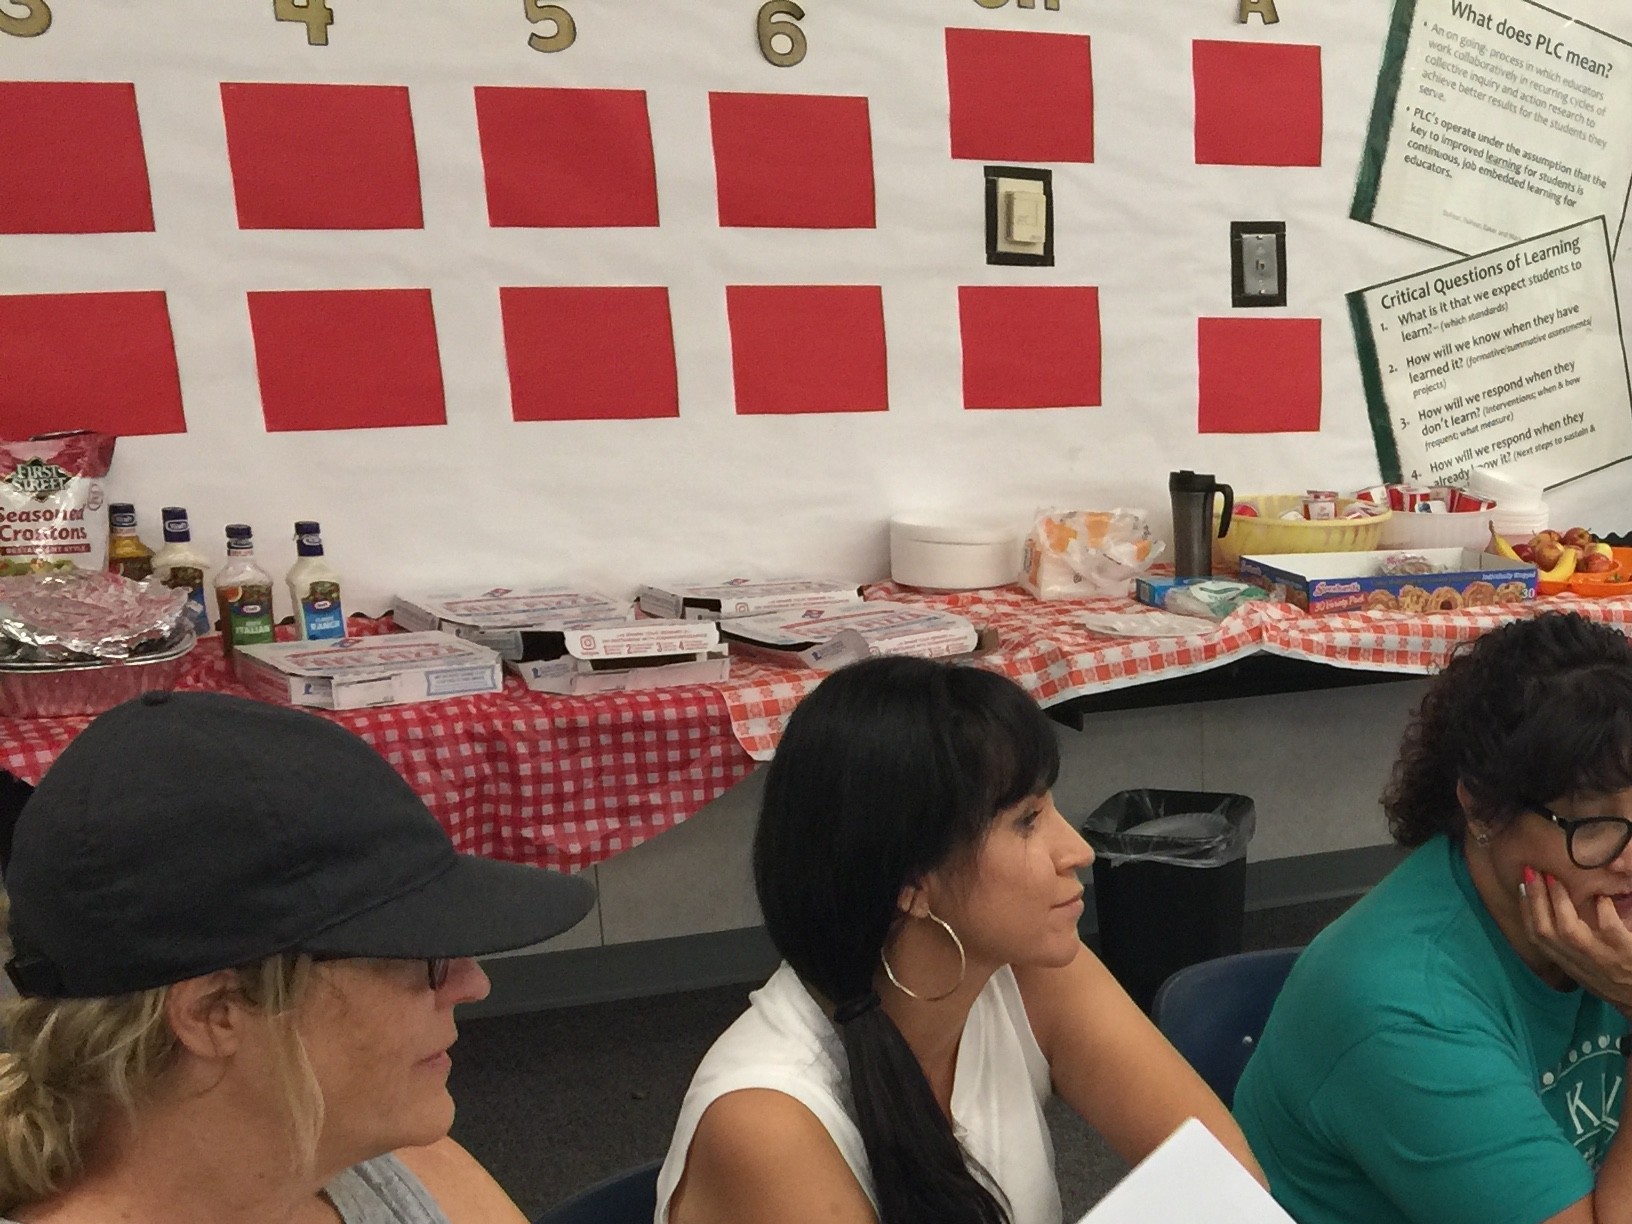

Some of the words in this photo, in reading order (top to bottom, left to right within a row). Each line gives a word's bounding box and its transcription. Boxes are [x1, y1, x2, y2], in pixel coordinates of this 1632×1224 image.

[273, 0, 334, 45] 4
[524, 0, 577, 53] 5
[756, 0, 807, 67] 6
[1451, 0, 1494, 31] What
[1495, 17, 1533, 47] does
[1535, 33, 1565, 60] PLC
[1565, 49, 1614, 79] mean?
[1403, 154, 1453, 179] educators.
[1409, 121, 1428, 140] key
[1429, 130, 1440, 143] to
[1440, 133, 1485, 159] improved
[1484, 149, 1523, 176] learning
[1523, 164, 1538, 178] for
[1538, 172, 1576, 193] students
[1575, 184, 1585, 196] is
[1440, 119, 1477, 140] operate
[1477, 133, 1505, 150] under
[1505, 142, 1521, 157] the
[1521, 149, 1573, 176] assumption
[1573, 167, 1592, 183] that
[1591, 175, 1608, 190] the
[1460, 156, 1478, 172] job
[1477, 165, 1527, 190] embedded
[1526, 180, 1563, 207] learning
[1563, 194, 1578, 208] for
[1380, 280, 1431, 310] Critical
[1433, 262, 1504, 297] Questions
[1506, 252, 1521, 272] of
[1523, 236, 1581, 267] Learning
[1397, 308, 1428, 327] What
[1428, 304, 1439, 317] is
[1439, 301, 1449, 313] it
[1449, 294, 1473, 311] that
[1472, 290, 1490, 303] we
[1491, 277, 1527, 297] expect
[1527, 264, 1570, 287] students
[1570, 260, 1583, 272] to
[1405, 352, 1431, 369] How
[1432, 343, 1453, 360] will
[1453, 340, 1471, 353] we
[1471, 330, 1501, 347] know
[1502, 320, 1532, 337] when
[1532, 312, 1555, 327] they
[1555, 304, 1580, 320] have
[1408, 360, 1451, 384] learned
[1450, 357, 1464, 371] it?
[1417, 405, 1443, 422] How
[1443, 395, 1464, 413] will
[1464, 393, 1481, 405] we
[1481, 375, 1524, 400] respond
[1524, 368, 1550, 385] when
[1549, 360, 1575, 377] they
[1429, 458, 1453, 474] How
[1454, 447, 1474, 465] will
[1473, 445, 1491, 457] we
[1491, 427, 1533, 452] respond
[1532, 419, 1562, 437] when
[1562, 411, 1585, 427] they
[1450, 406, 1481, 427] learn?
[16, 464, 60, 479] FIRST
[1499, 451, 1512, 465] it?
[1554, 436, 1564, 446] to
[11, 478, 67, 492] STREET
[1521, 588, 1535, 599] 30
[235, 625, 270, 634] ITALIAN
